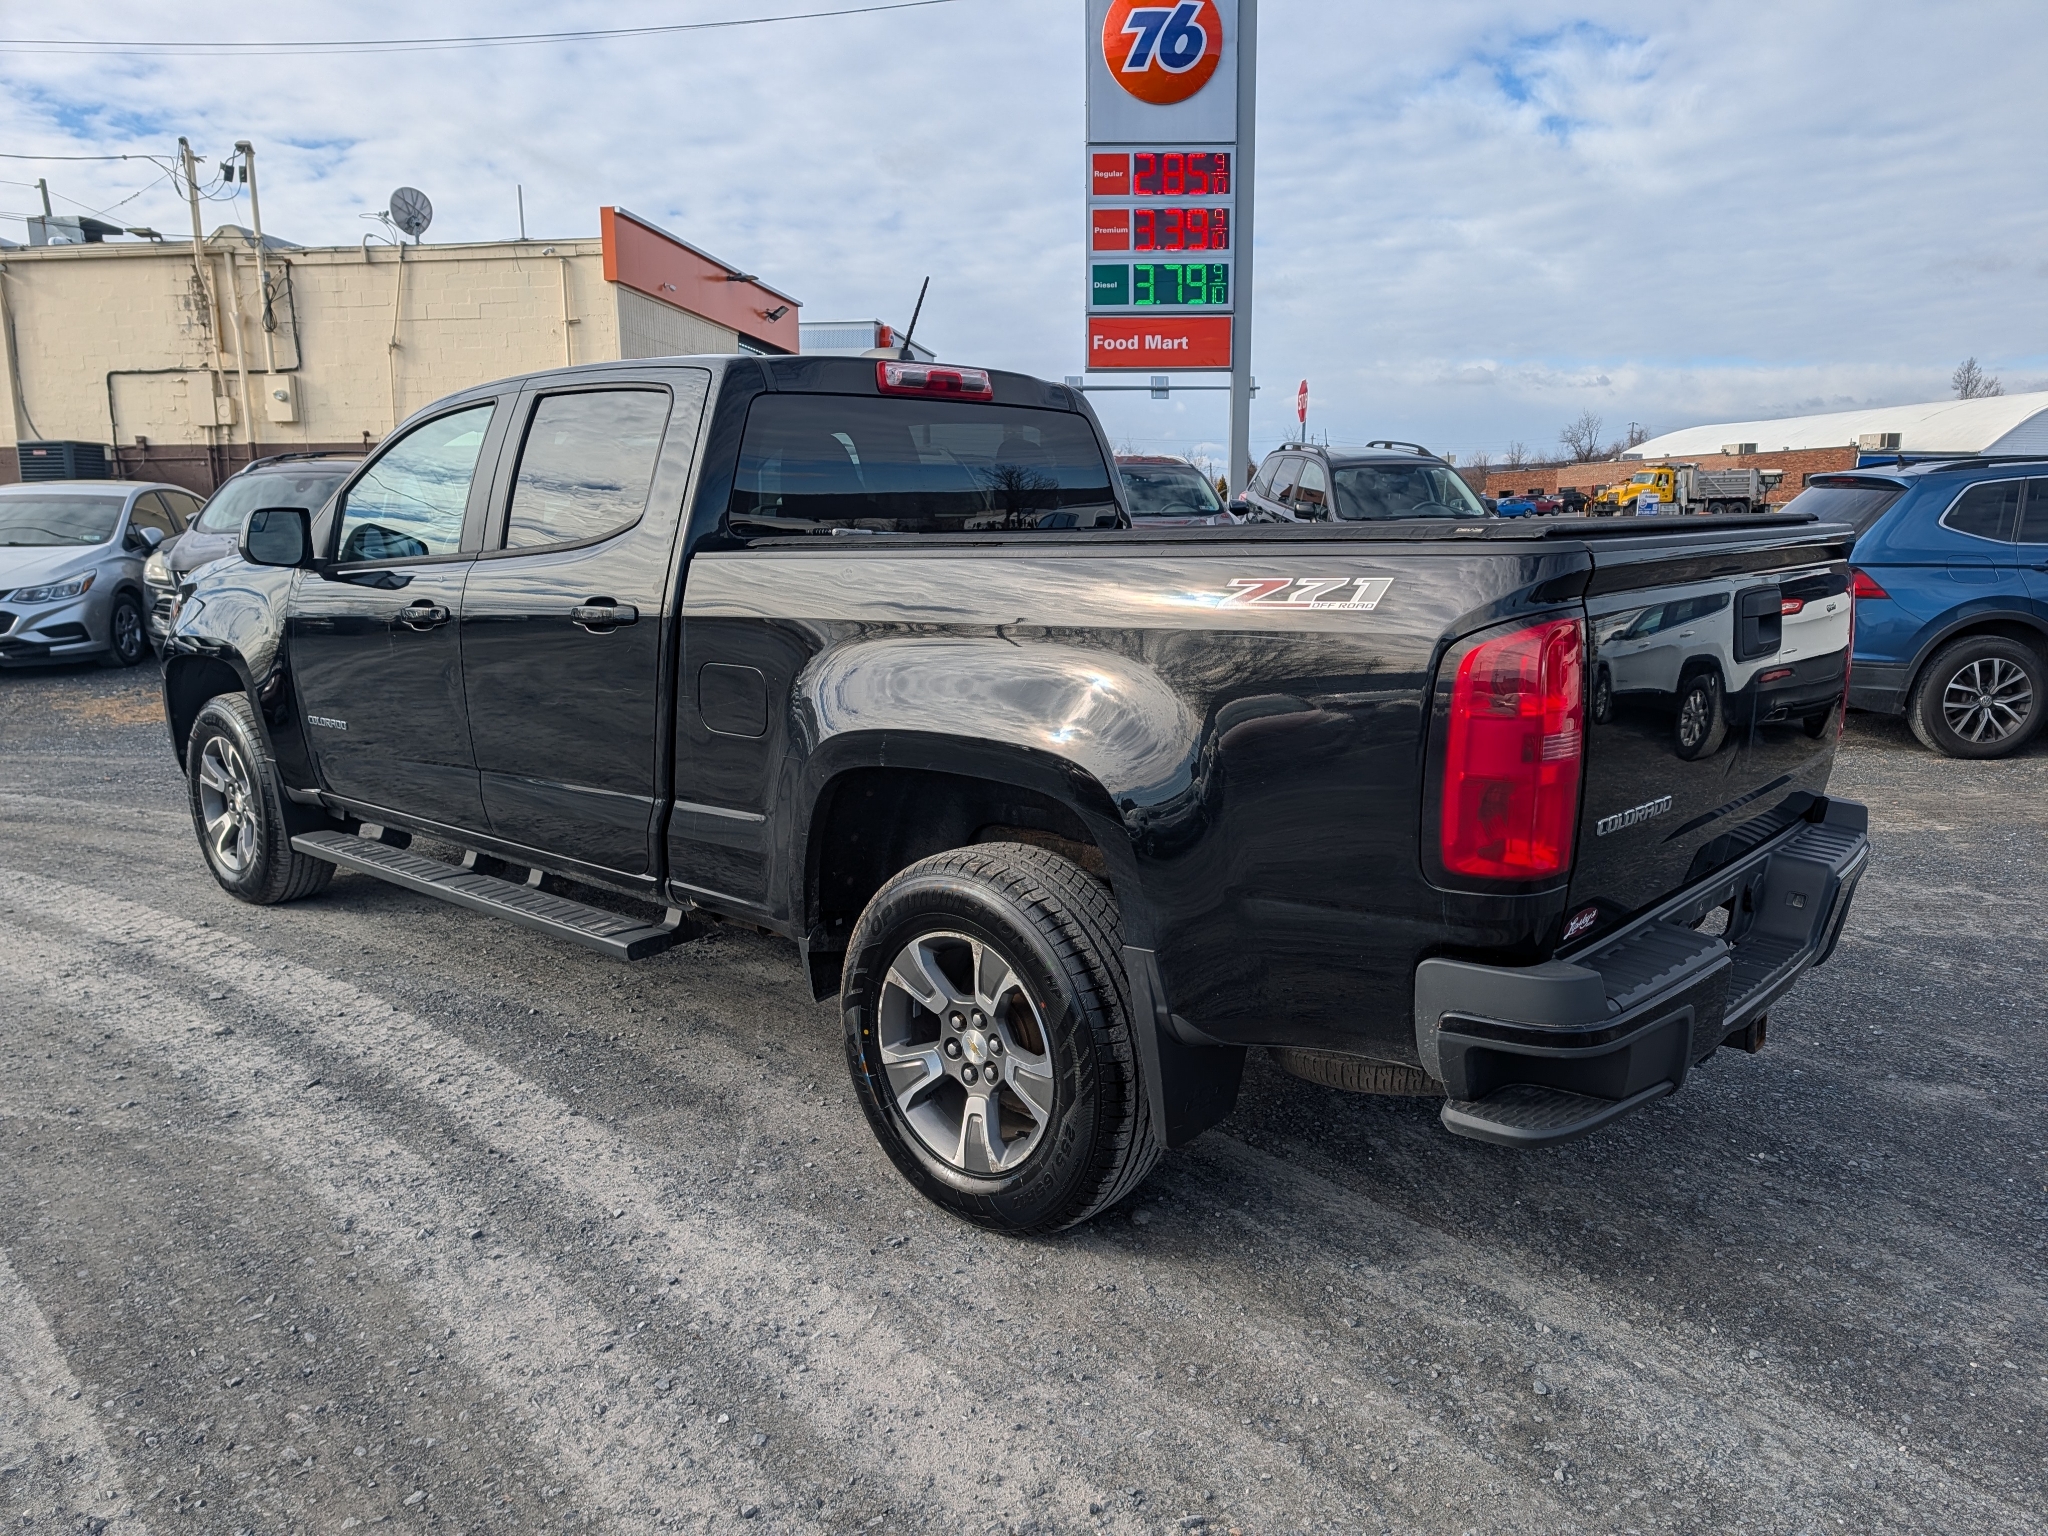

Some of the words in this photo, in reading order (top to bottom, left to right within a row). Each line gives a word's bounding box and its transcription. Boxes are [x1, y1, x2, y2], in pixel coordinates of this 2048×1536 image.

[1121, 0, 1207, 73] 76
[1094, 170, 1124, 179] Regular
[1134, 153, 1209, 195] 2.85
[1094, 226, 1129, 234] Premium
[1135, 208, 1209, 251] 3.39
[1094, 281, 1118, 289] Diesel
[1134, 264, 1207, 305] 3.79
[1093, 335, 1139, 350] Food
[1144, 335, 1189, 350] Mart
[1298, 392, 1308, 411] STOP
[1215, 577, 1395, 611] Z71
[308, 715, 348, 731] COLORADO
[1596, 795, 1673, 837] COLORADO
